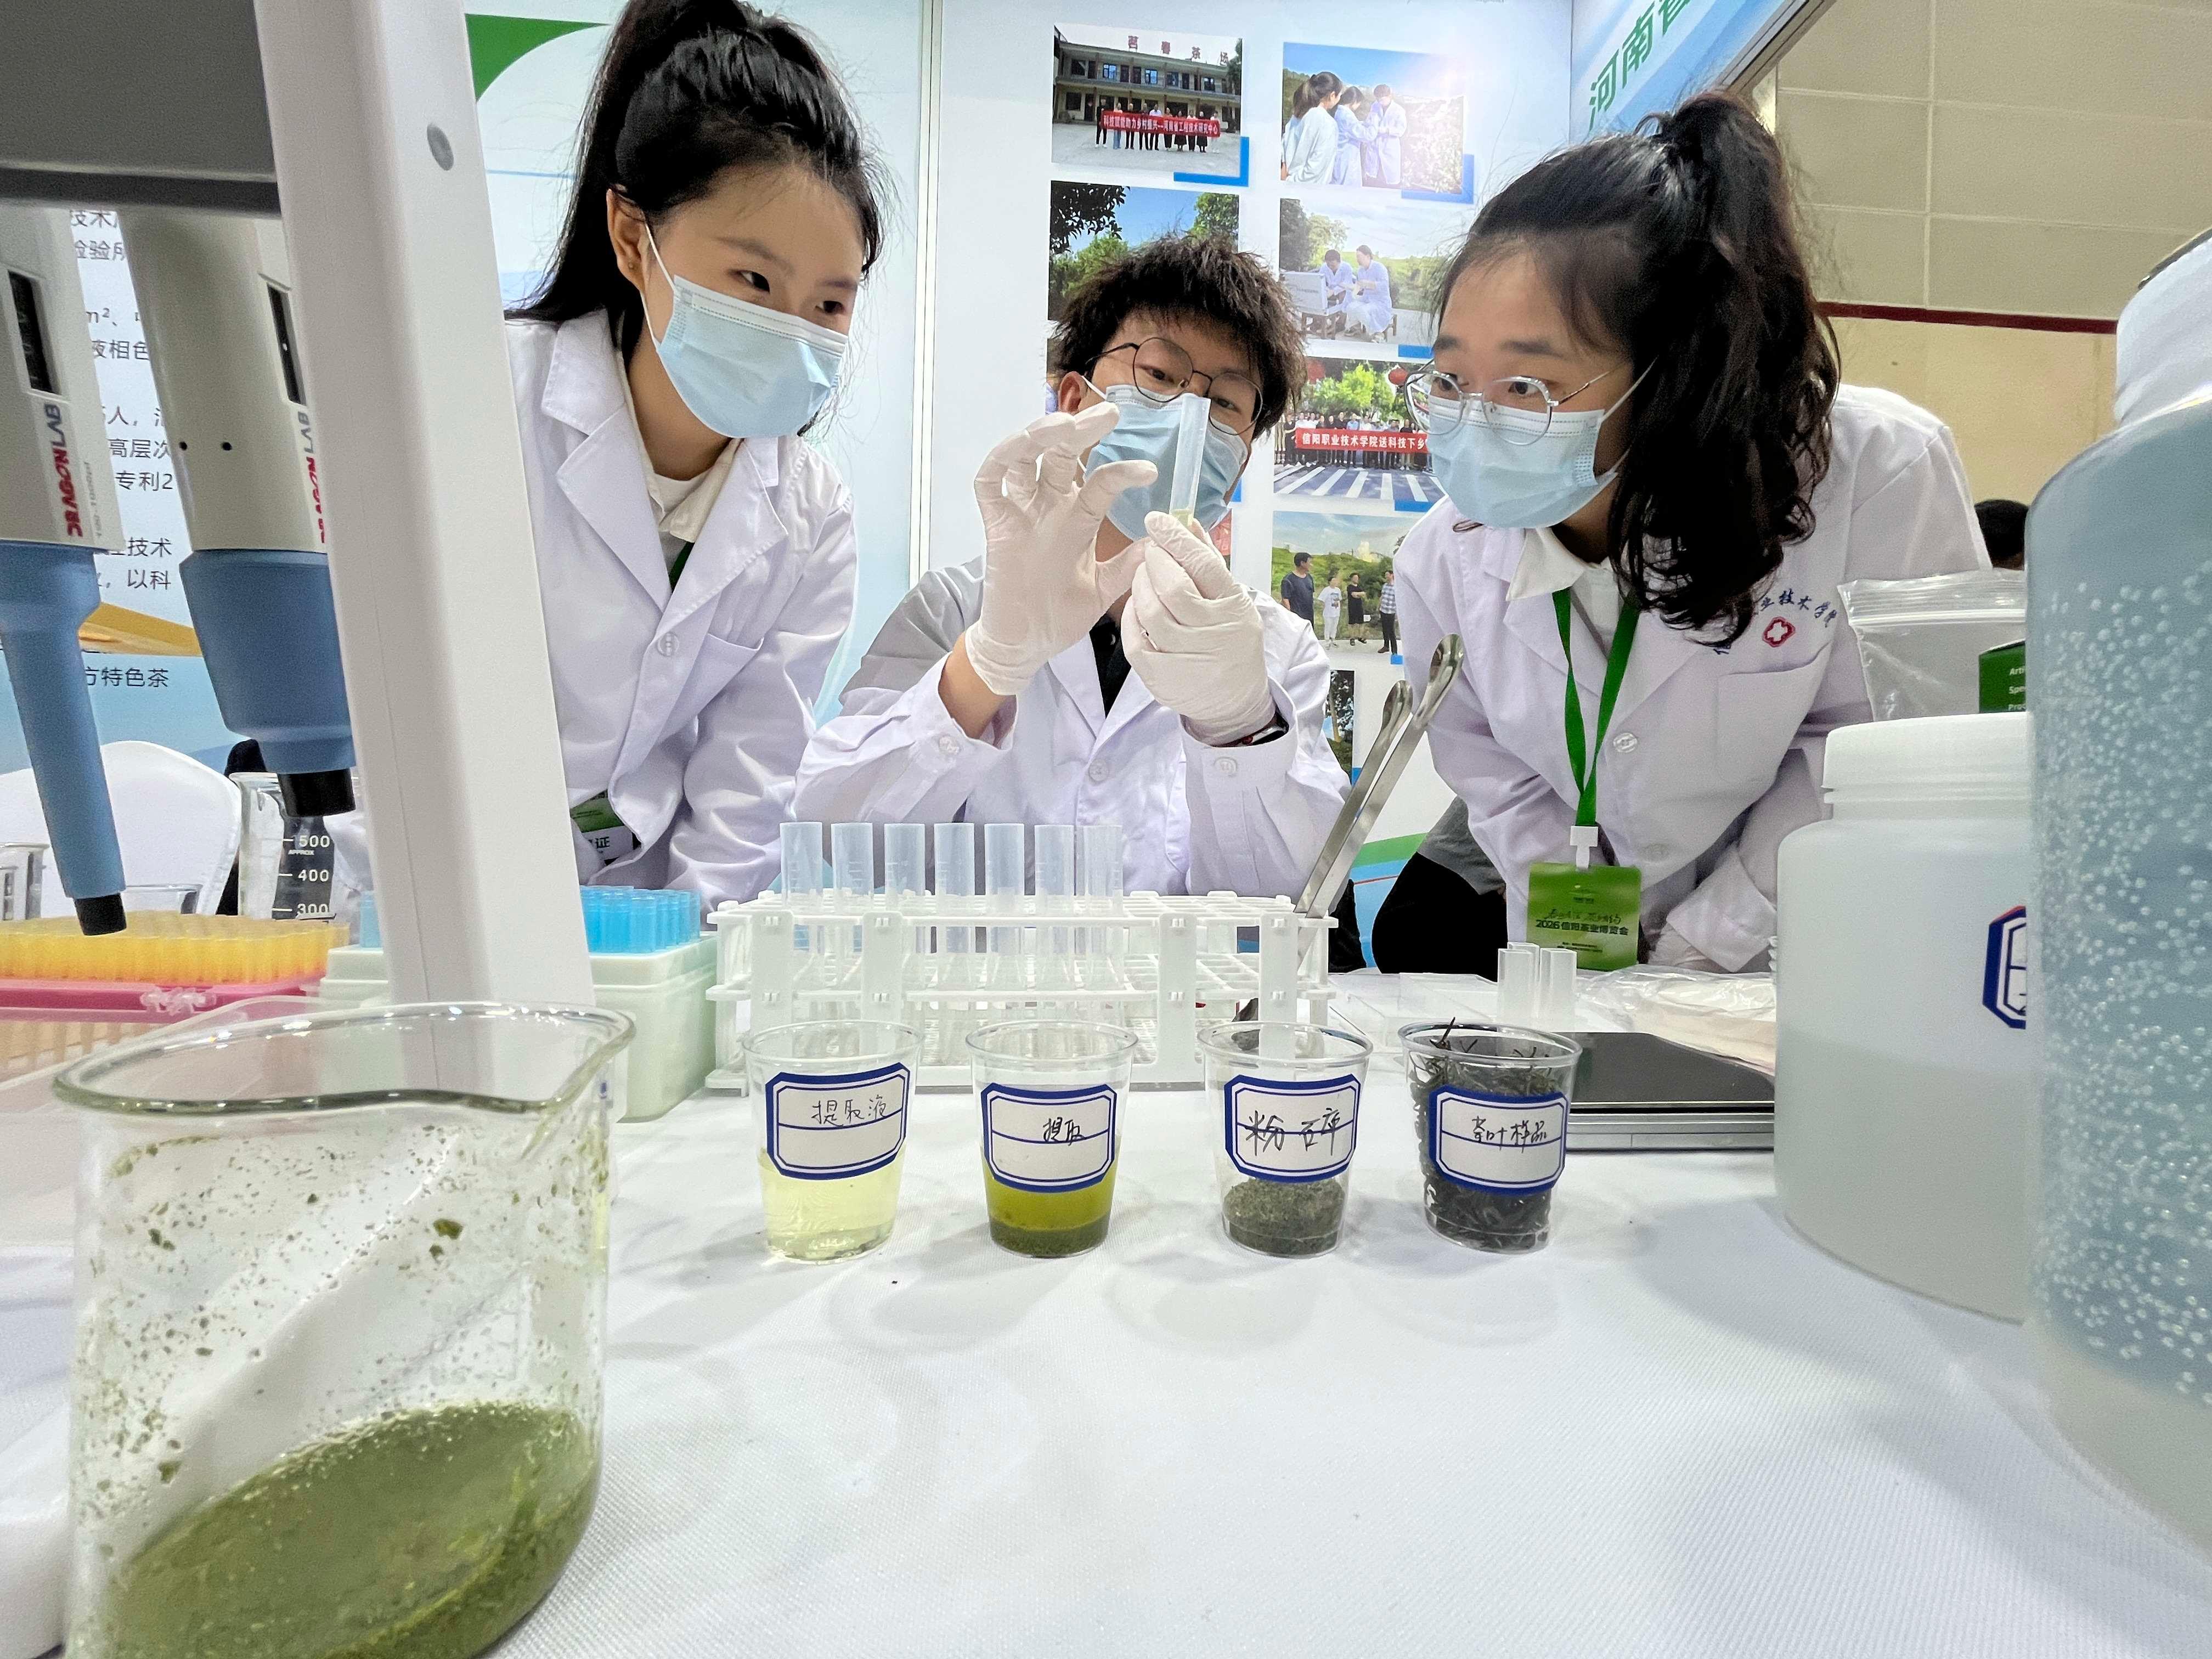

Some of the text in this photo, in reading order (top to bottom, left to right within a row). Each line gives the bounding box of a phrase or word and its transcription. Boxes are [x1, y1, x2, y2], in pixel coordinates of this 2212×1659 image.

[298, 835, 330, 848] 500
[298, 869, 329, 882] 400
[297, 903, 329, 915] 300
[811, 1094, 887, 1126] 提取液
